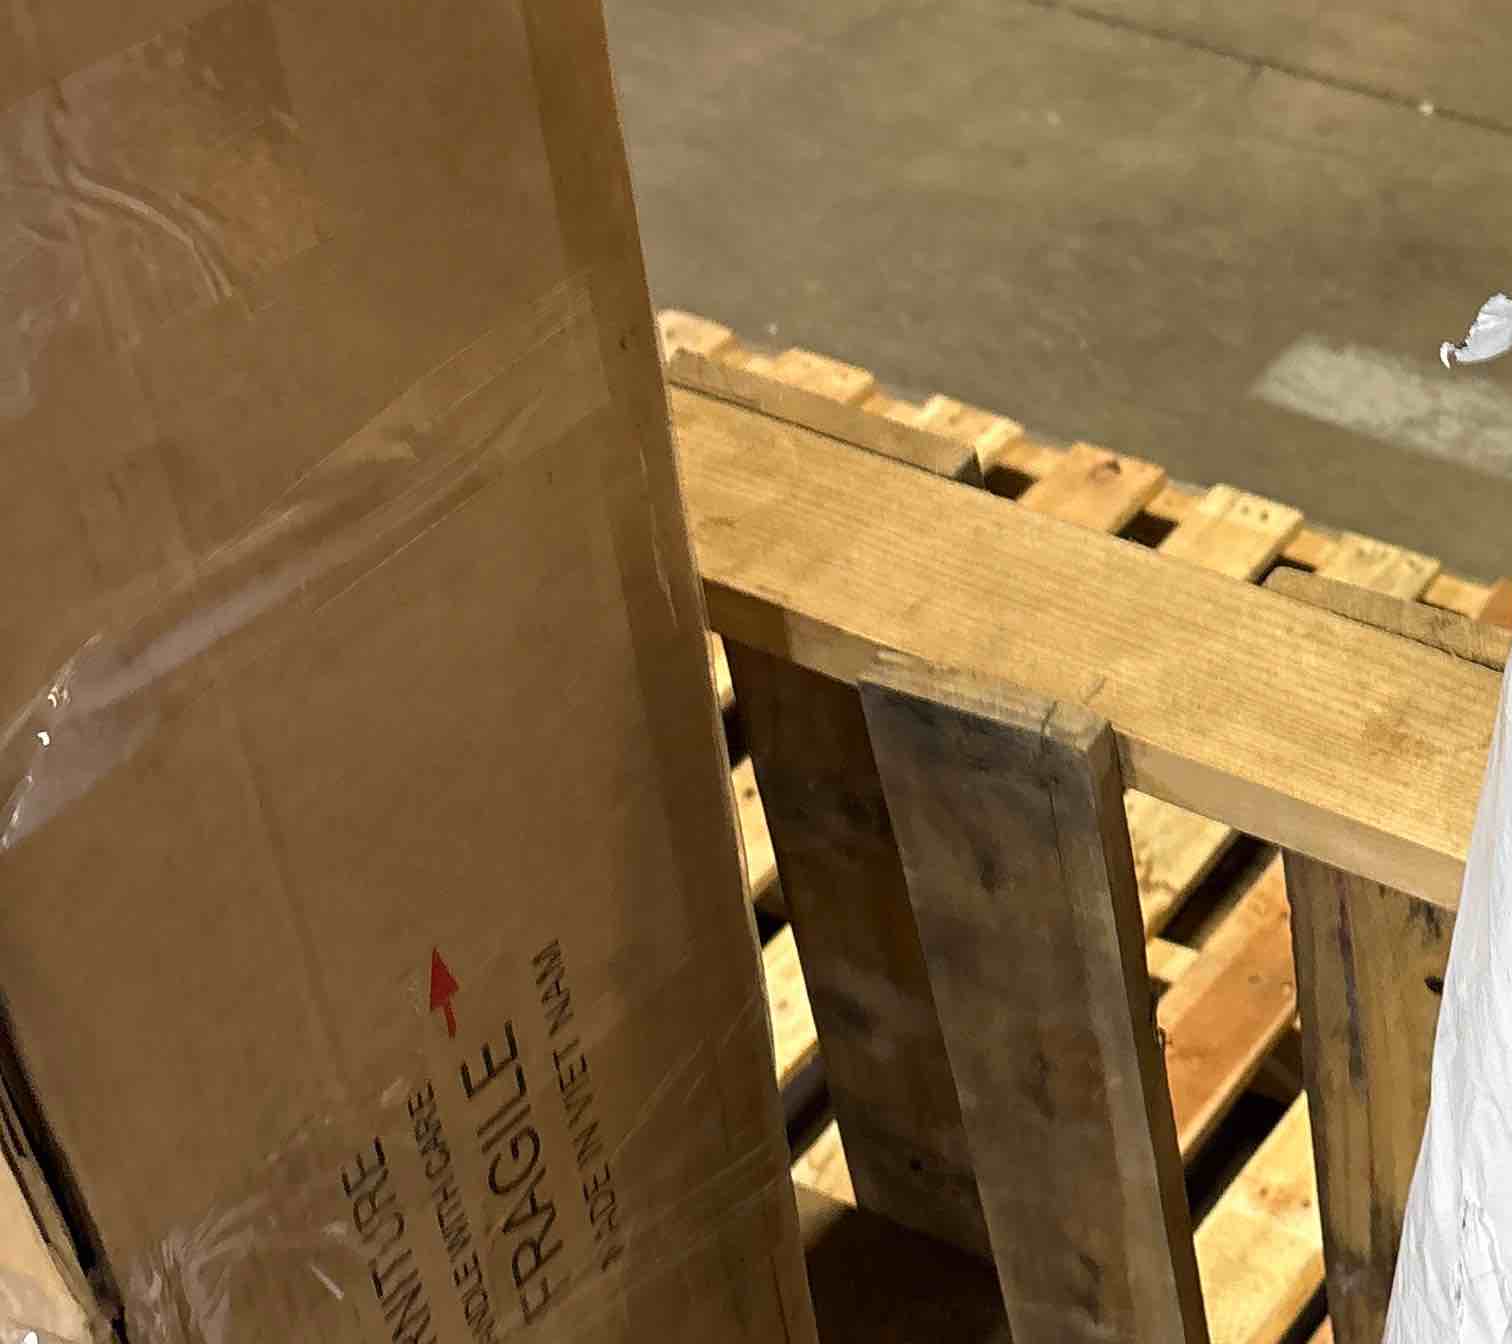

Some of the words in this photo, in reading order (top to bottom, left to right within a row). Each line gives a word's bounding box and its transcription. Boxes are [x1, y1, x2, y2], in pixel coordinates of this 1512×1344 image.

[530, 938, 576, 1039] NAM
[405, 1077, 452, 1181] CARE
[551, 1037, 597, 1130] VIET
[458, 1018, 566, 1326] FRAGILE
[573, 1120, 603, 1166] IN
